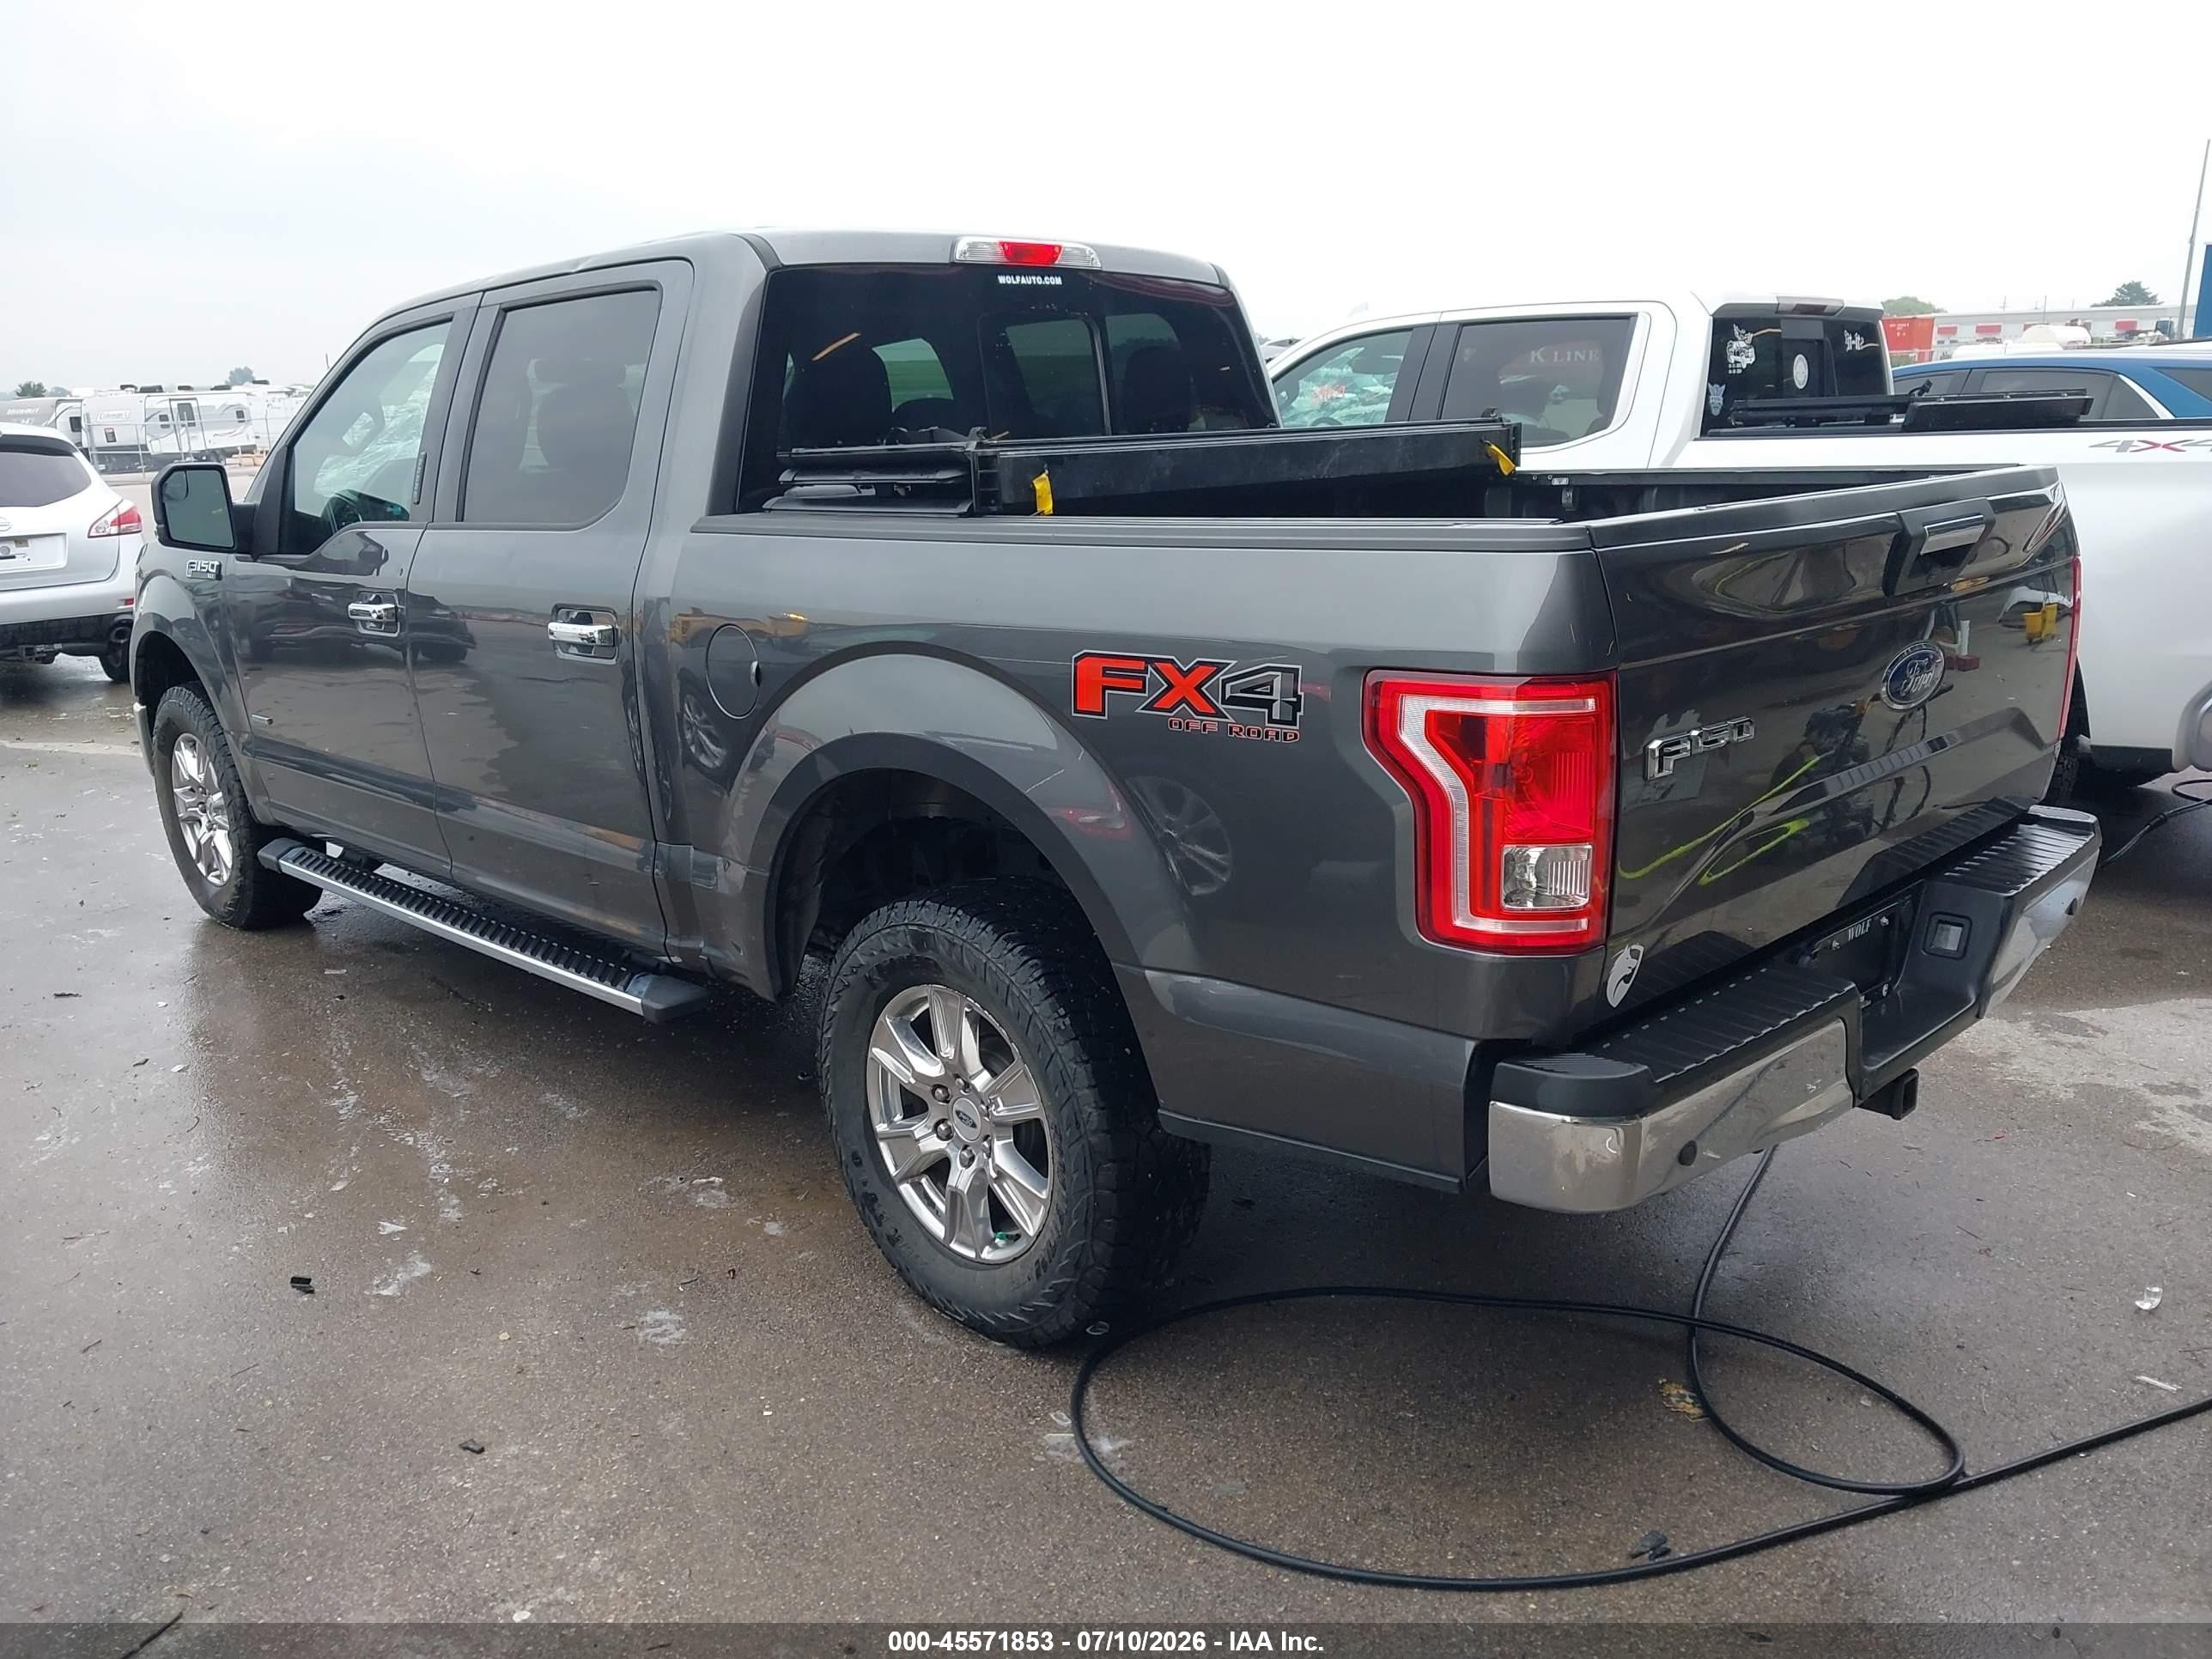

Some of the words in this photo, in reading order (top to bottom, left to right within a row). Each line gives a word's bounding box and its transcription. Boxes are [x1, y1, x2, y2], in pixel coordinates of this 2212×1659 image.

[997, 275, 1062, 285] WOLFAUTO.COM
[1530, 345, 1546, 362] K
[1553, 350, 1599, 362] LINE
[1073, 649, 1304, 730] FX4
[1900, 658, 1936, 696] Ford
[1168, 717, 1218, 734] OFF
[1228, 722, 1300, 744] ROAD
[1848, 918, 1872, 941] WOLF
